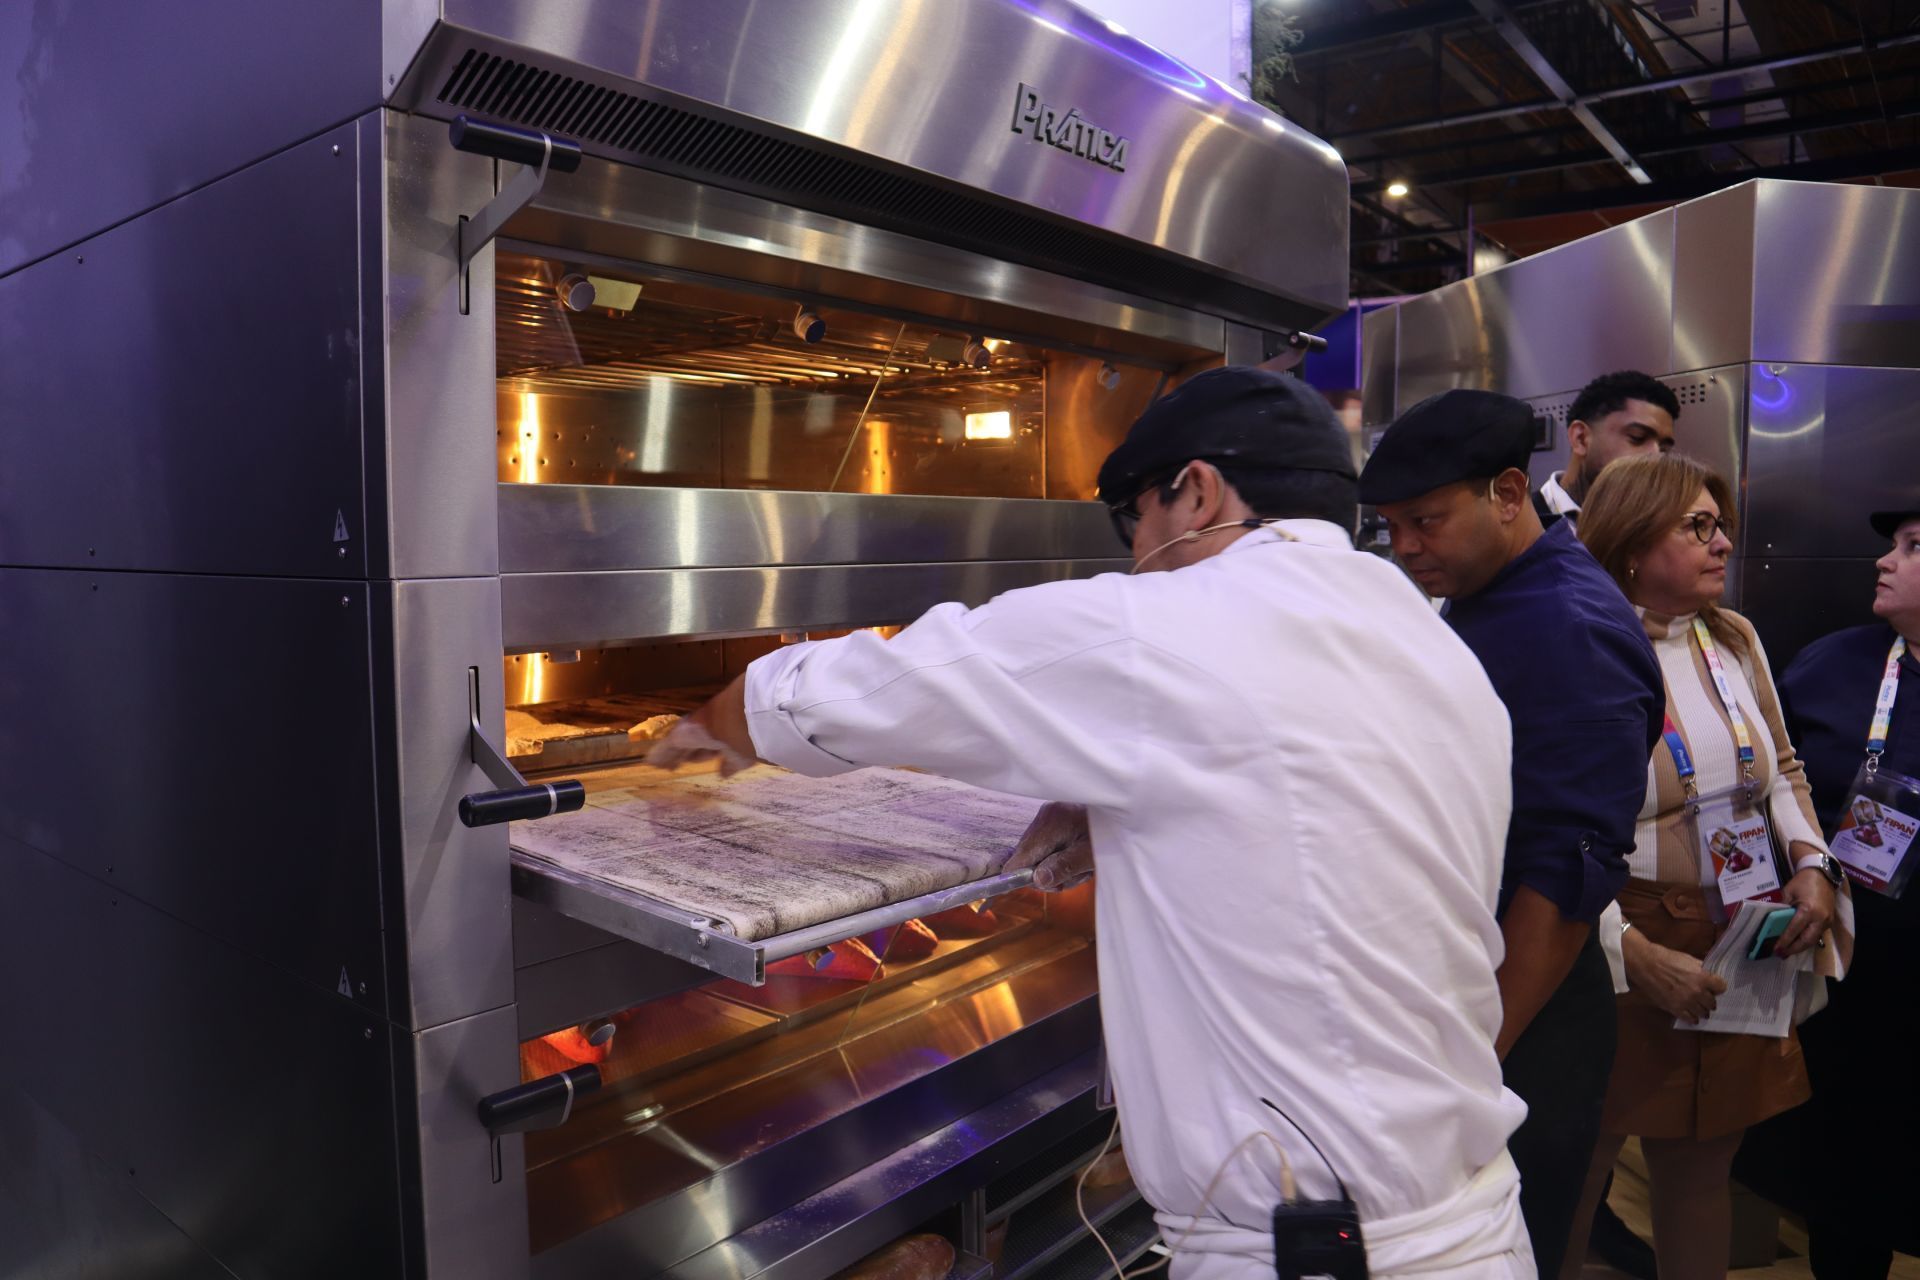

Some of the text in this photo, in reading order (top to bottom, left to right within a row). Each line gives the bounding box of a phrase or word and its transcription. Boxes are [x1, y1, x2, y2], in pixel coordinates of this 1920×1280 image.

[1011, 82, 1130, 172] PRÁTICA
[1739, 826, 1766, 841] FIPAN
[1883, 816, 1916, 836] FIPAN
